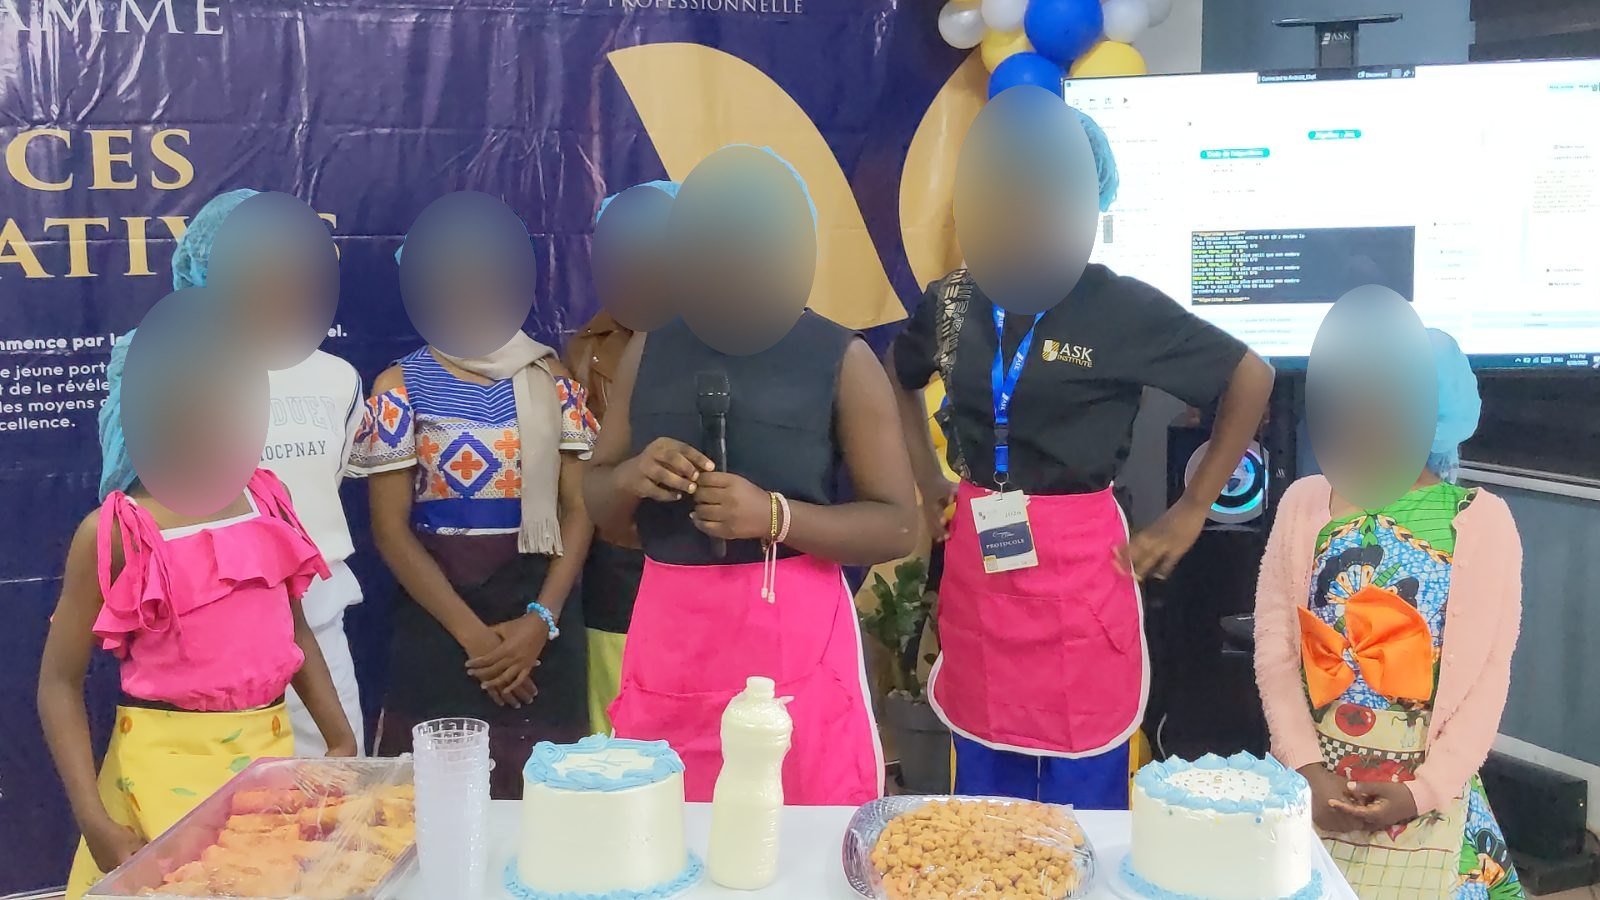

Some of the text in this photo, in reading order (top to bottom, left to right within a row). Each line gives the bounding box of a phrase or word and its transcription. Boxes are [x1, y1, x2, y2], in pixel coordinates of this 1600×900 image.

[5, 129, 195, 190] CES
[73, 336, 105, 351] par
[328, 324, 347, 337] el.
[1057, 354, 1093, 368] INSTITUTE
[1060, 343, 1093, 361] ASK
[13, 365, 64, 380] jeune
[69, 362, 106, 378] port
[9, 383, 31, 395] de
[37, 381, 52, 394] le
[57, 379, 109, 393] révéle
[28, 399, 95, 413] moyens
[260, 440, 326, 462] OCPNAY
